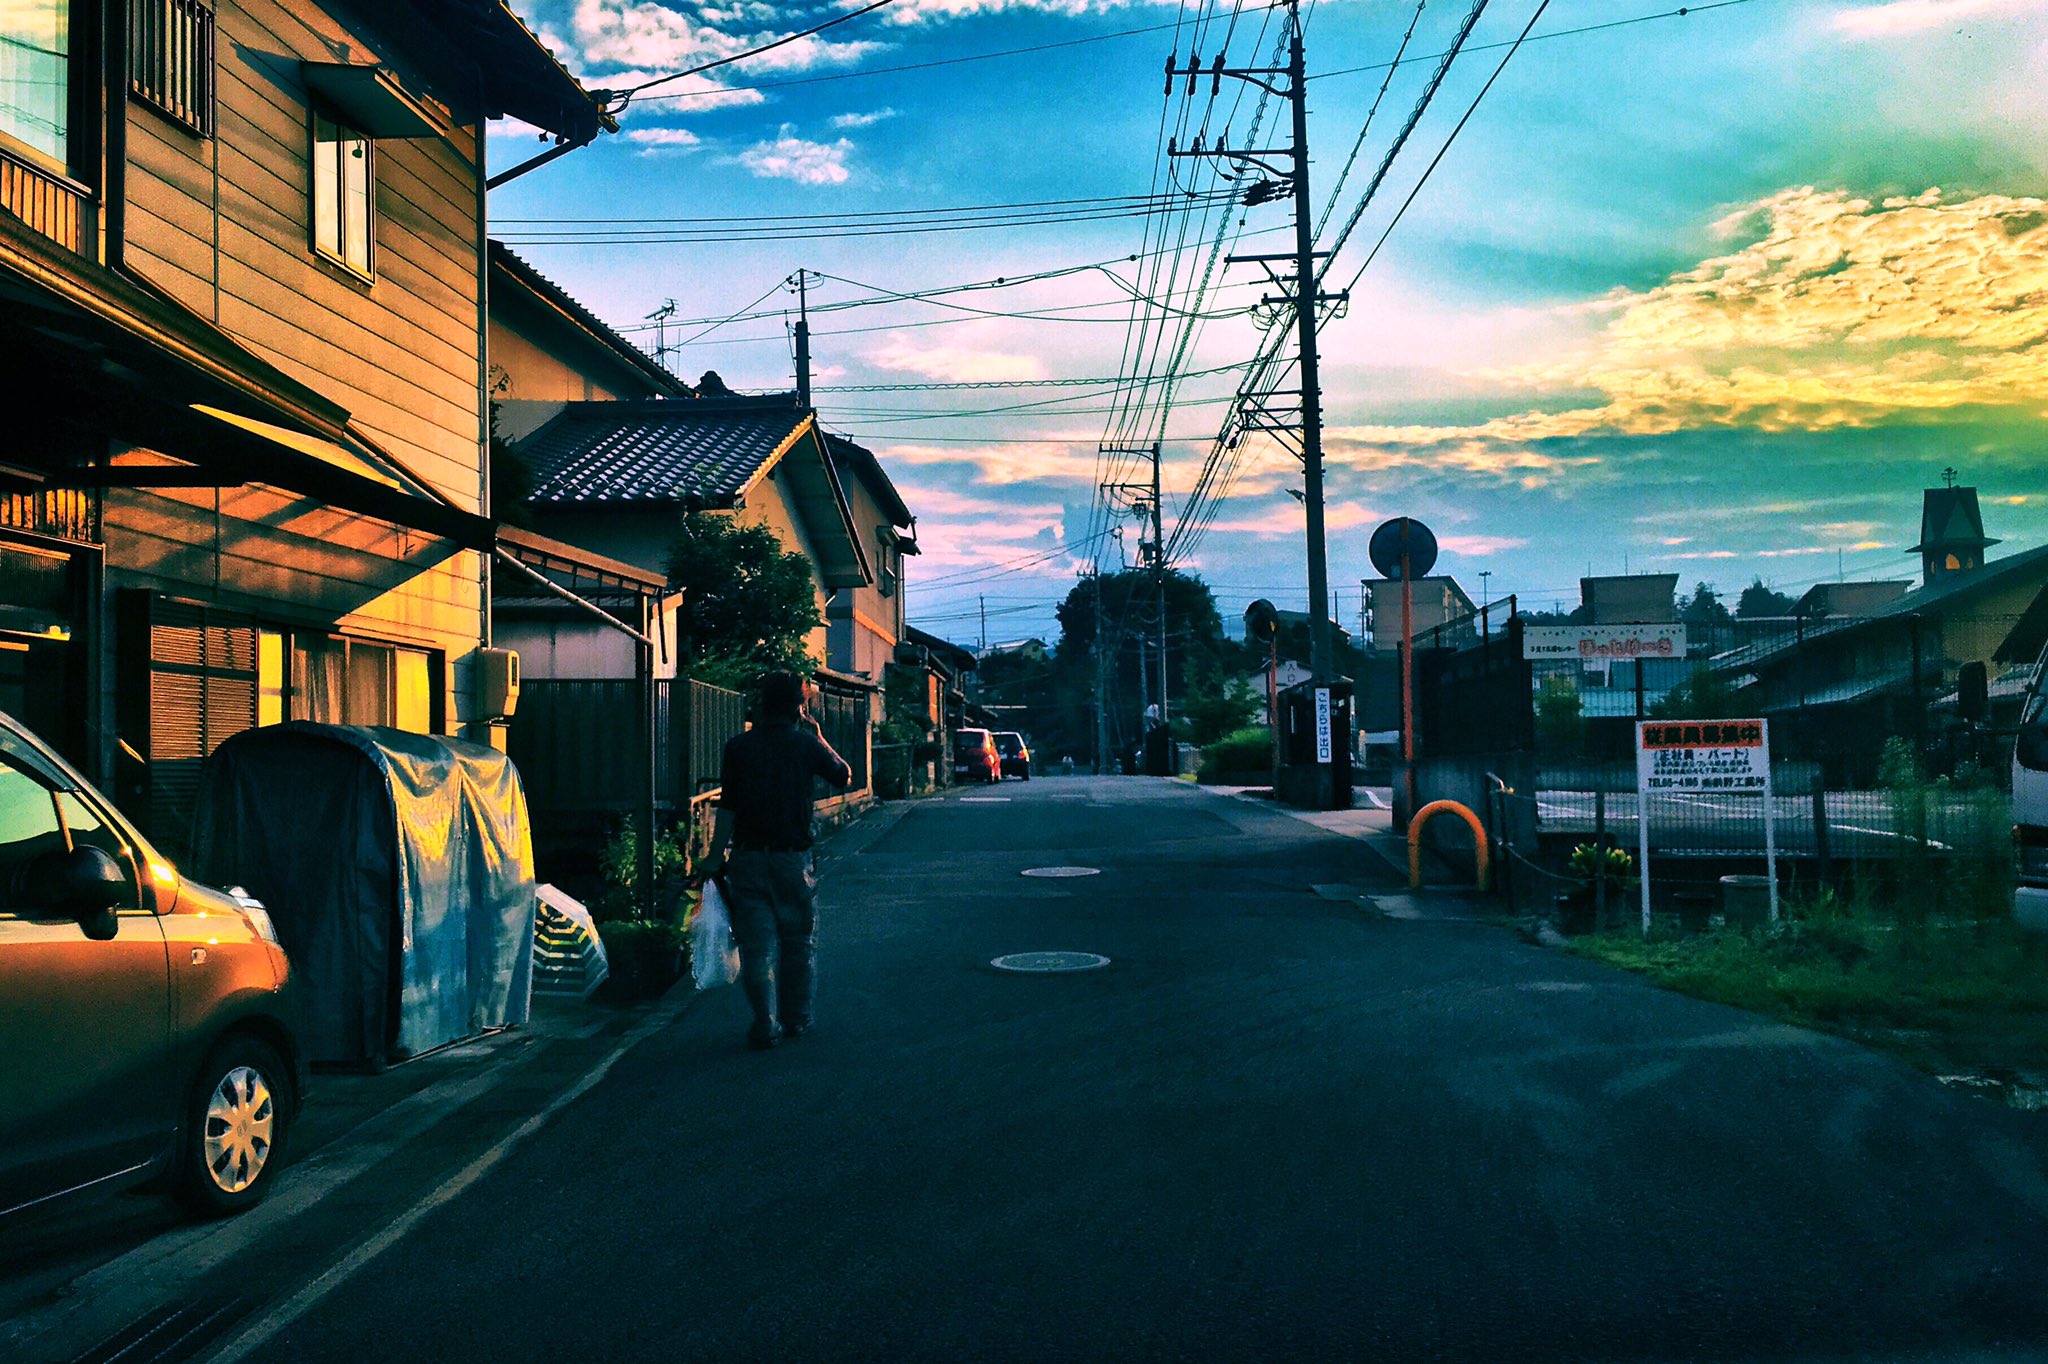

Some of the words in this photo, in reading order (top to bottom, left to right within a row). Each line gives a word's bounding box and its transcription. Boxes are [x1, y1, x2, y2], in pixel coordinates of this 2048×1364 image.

[1318, 692, 1329, 758] こちらは出口
